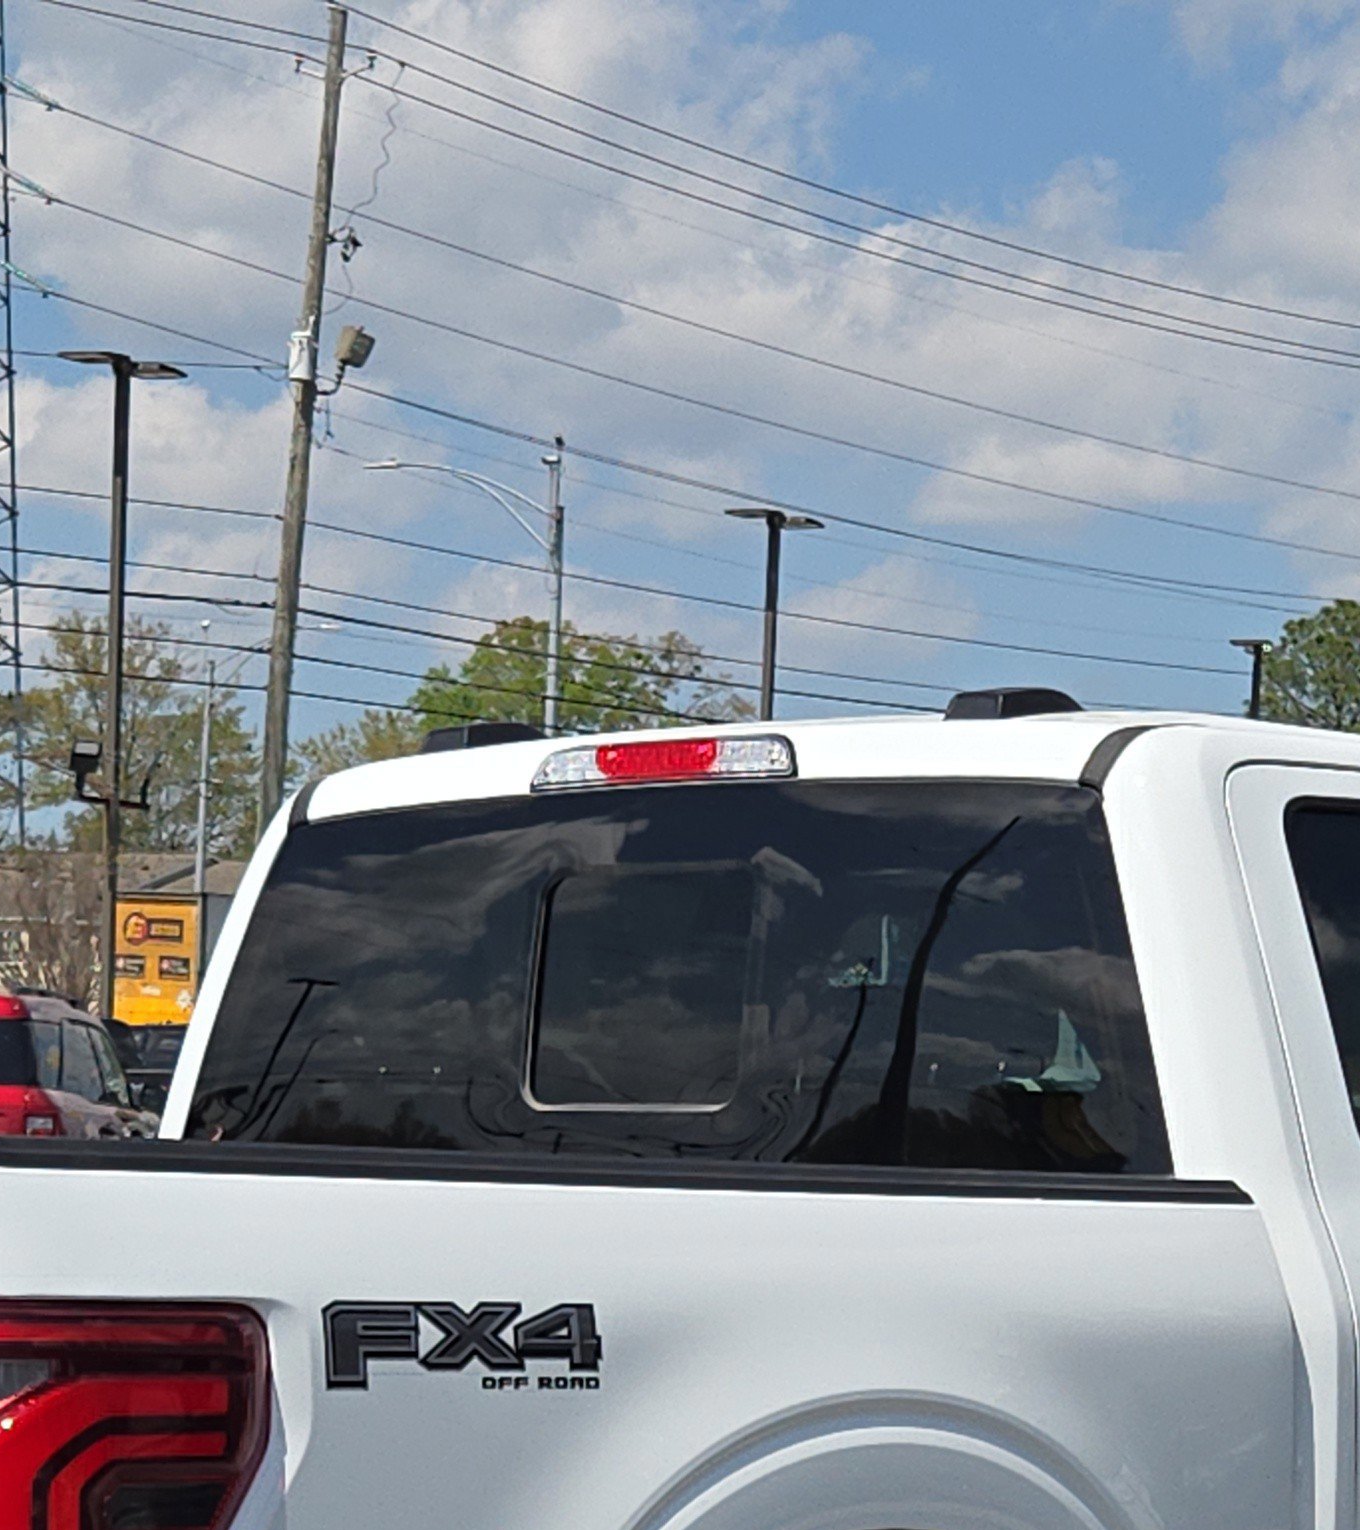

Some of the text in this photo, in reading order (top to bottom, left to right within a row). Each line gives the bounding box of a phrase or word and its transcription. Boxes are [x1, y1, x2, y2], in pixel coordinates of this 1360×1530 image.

[321, 1300, 603, 1390] FX4
[482, 1376, 600, 1390] OFF ROAD
